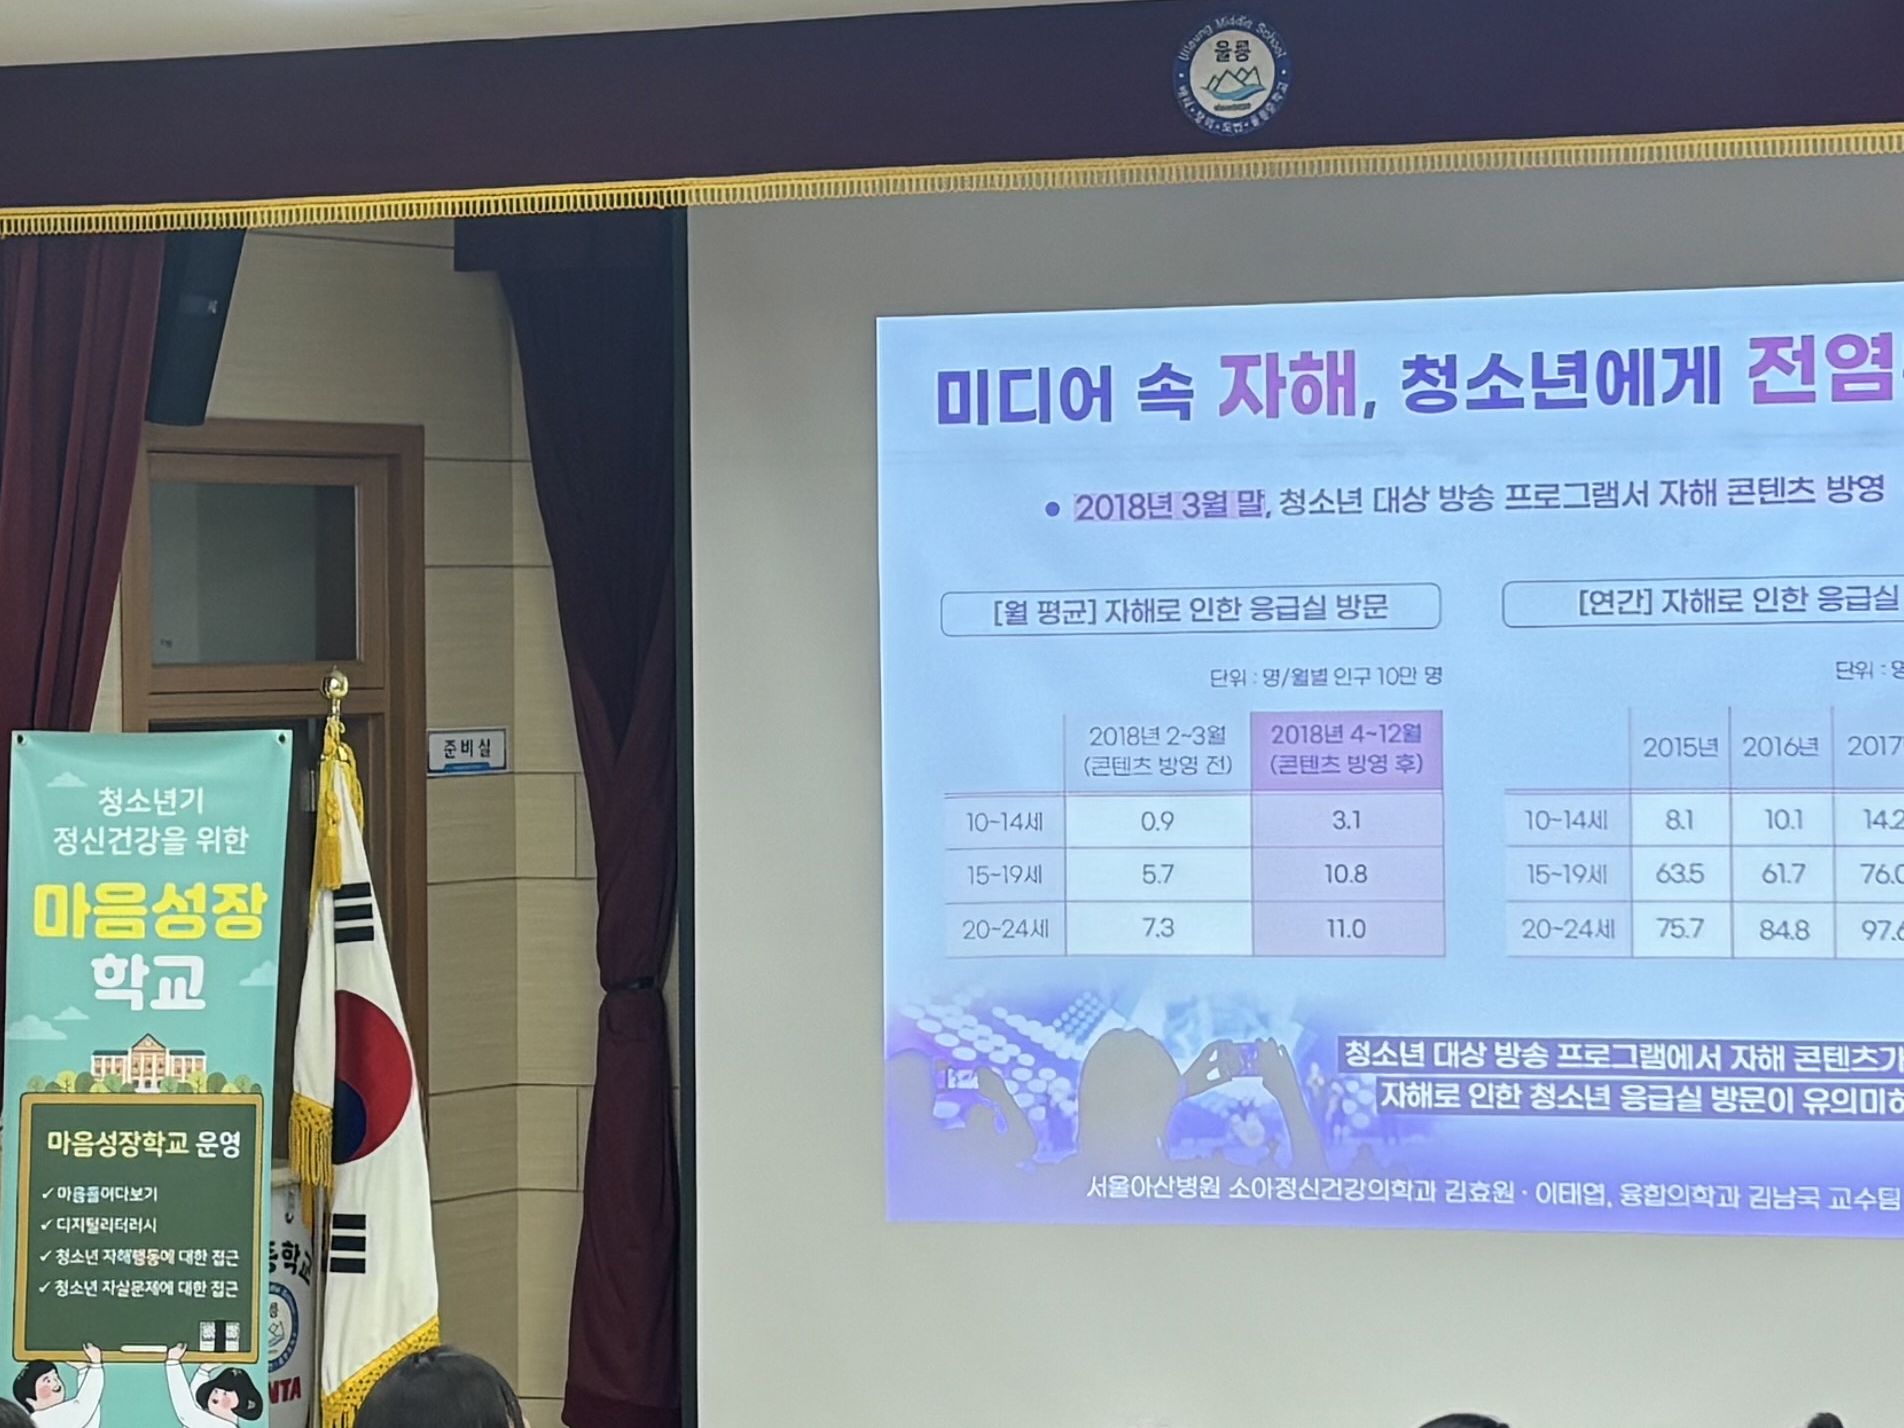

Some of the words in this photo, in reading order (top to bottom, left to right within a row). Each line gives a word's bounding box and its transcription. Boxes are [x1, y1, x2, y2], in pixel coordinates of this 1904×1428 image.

[1214, 40, 1251, 62] 울릉
[937, 365, 1113, 425] 미디어
[1137, 362, 1195, 421] 속
[1219, 350, 1376, 420] 자해,
[1401, 345, 1720, 414] 청소년에게
[1075, 493, 1174, 521] 2018년
[1181, 492, 1231, 519] 3월
[1237, 489, 1272, 519] 말,
[1279, 487, 1363, 516] 청소년
[1373, 485, 1429, 514] 대상
[1439, 484, 1495, 513] 방송
[1505, 480, 1650, 510] 프로그램서
[1659, 478, 1717, 508] 자해
[1727, 477, 1817, 506] 콘텐츠
[1827, 475, 1886, 503] 방영
[994, 600, 1029, 626] [월
[1037, 599, 1097, 625] 평균]
[1105, 598, 1182, 624] 자해로
[1190, 597, 1242, 622] 인한
[1250, 595, 1327, 621] 응급실
[1336, 594, 1389, 620] 방문
[1578, 588, 1653, 616] [연간]
[1662, 588, 1744, 614] 자해로
[1752, 587, 1808, 613] 인한
[1817, 586, 1899, 611] 응급실
[1210, 669, 1248, 688] 단위
[1262, 667, 1327, 688] 명/월별
[1334, 667, 1372, 687] 인구
[1377, 667, 1417, 686] 10만
[1425, 666, 1442, 686] 명
[1836, 660, 1873, 680] 단위
[1089, 727, 1160, 746] 2018년
[1167, 726, 1226, 745] 2~3월
[1271, 724, 1344, 745] 2018년
[1350, 724, 1422, 743] 4~12월
[444, 738, 491, 759] 준비실
[1643, 737, 1719, 758] 2015년
[1743, 736, 1819, 757] 2016년
[1083, 756, 1153, 777] (콘텐츠
[1159, 755, 1198, 776] 방영
[1206, 754, 1232, 776] 전)
[1270, 754, 1341, 775] (콘텐츠
[1348, 754, 1388, 774] 방영
[1395, 753, 1423, 774] 후)
[98, 786, 204, 817] 청소년기
[967, 811, 1043, 832] 10~14세
[1140, 811, 1174, 831] 0.9
[1332, 810, 1361, 830] 3.1
[1525, 809, 1608, 830] 10~14세
[1665, 809, 1694, 830] 8.1
[1765, 809, 1803, 830] 10.1
[53, 826, 188, 856] 정신건강을
[196, 826, 250, 855] 위한
[968, 864, 1042, 886] 15~19세
[1142, 864, 1174, 884] 5.7
[1325, 864, 1368, 884] 10.8
[1527, 864, 1607, 885] 15~19세
[1656, 863, 1705, 884] 63.5
[1762, 863, 1806, 884] 61.7
[34, 881, 268, 940] 마음성장
[962, 918, 1049, 940] 20~24세
[1142, 917, 1175, 938] 7.3
[1327, 918, 1366, 939] 11.0
[1522, 918, 1616, 940] 20~24세
[1656, 918, 1704, 939] 75.7
[1760, 919, 1810, 941] 84.8
[91, 952, 206, 1012] 학교
[1345, 1041, 1425, 1068] 청소년
[1434, 1041, 1486, 1068] 대상
[1495, 1042, 1548, 1069] 방송
[1557, 1042, 1721, 1071] 프로그램에서
[1731, 1044, 1785, 1071] 자해
[1381, 1082, 1461, 1109] 자해로
[1468, 1083, 1522, 1110] 인한
[1530, 1084, 1610, 1111] 청소년
[1620, 1084, 1702, 1112] 응급실
[1711, 1086, 1793, 1114] 방문이
[47, 1130, 189, 1158] 마음성장학교
[196, 1130, 241, 1158] 운영
[1087, 1174, 1220, 1200] 서울아산병원
[1228, 1176, 1436, 1203] 소아정신건강의학과
[1445, 1180, 1514, 1204] 김효원
[1620, 1182, 1740, 1209] 융합의학과
[1748, 1185, 1820, 1210] 김남국
[1828, 1187, 1900, 1211] 교수팀
[57, 1217, 157, 1234] 디지털리터러시
[56, 1249, 98, 1266] 청소년
[179, 1249, 207, 1266] 대한
[212, 1250, 239, 1267] 접근
[55, 1280, 98, 1297] 청소년
[178, 1280, 207, 1297] 대한
[211, 1281, 239, 1298] 접근
